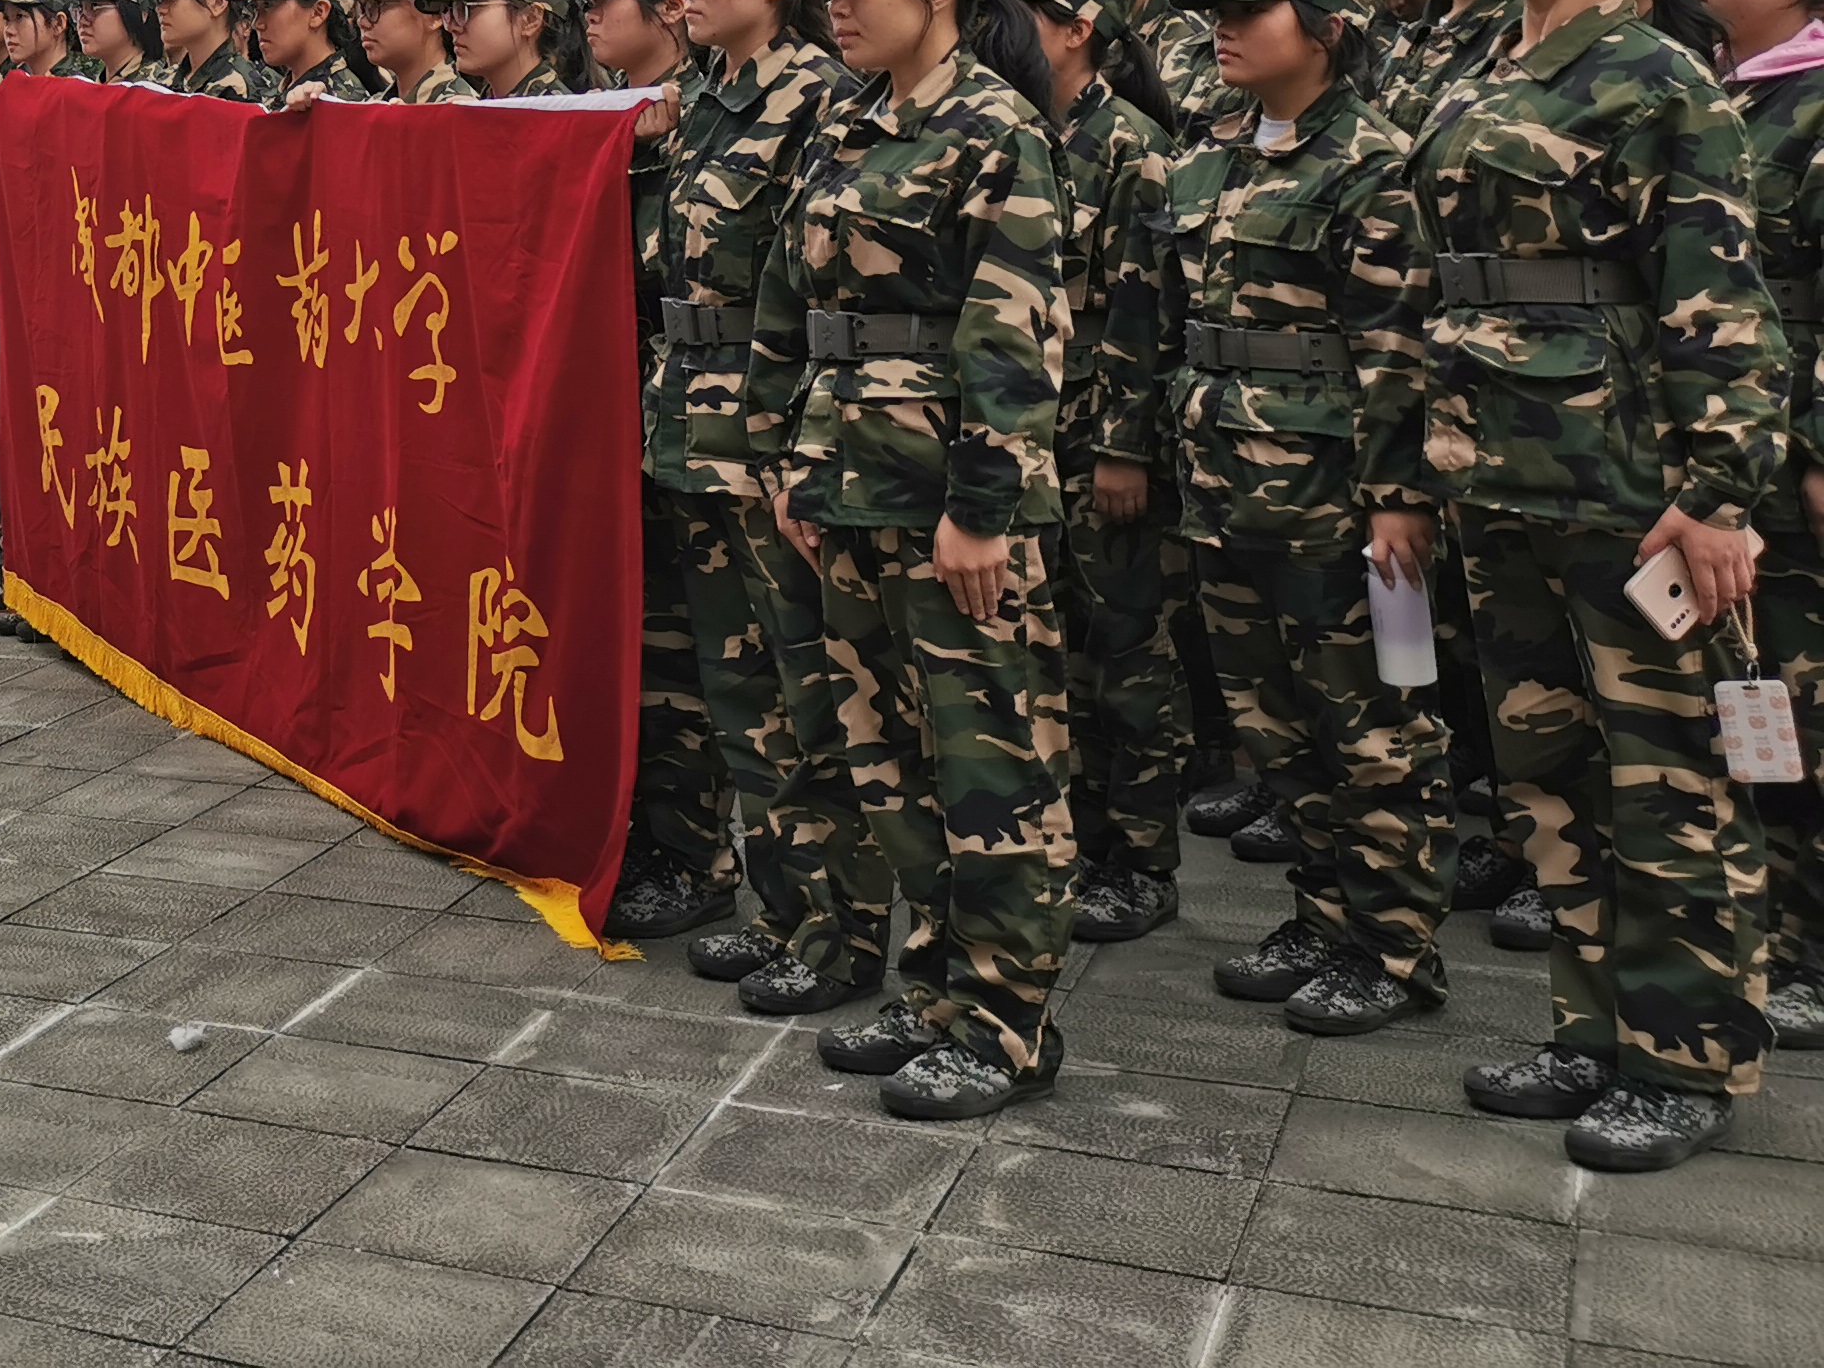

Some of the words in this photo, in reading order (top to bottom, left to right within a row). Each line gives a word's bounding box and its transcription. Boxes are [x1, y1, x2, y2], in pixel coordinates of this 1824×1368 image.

[71, 166, 458, 414] 成都中医药大学
[36, 385, 564, 762] 民族医药学院
